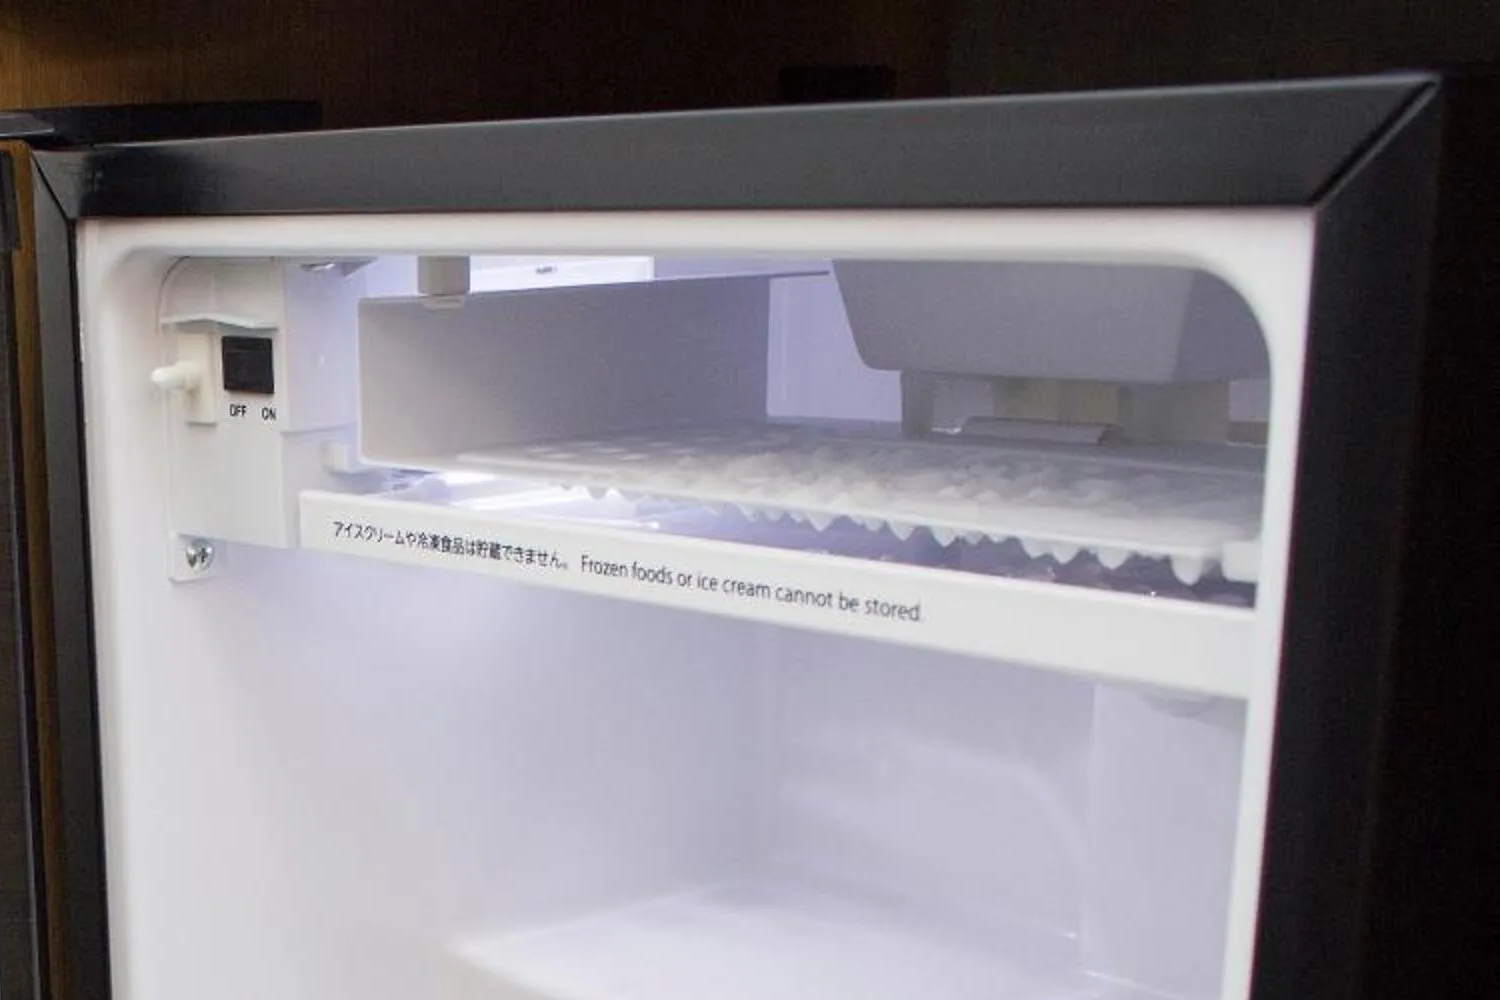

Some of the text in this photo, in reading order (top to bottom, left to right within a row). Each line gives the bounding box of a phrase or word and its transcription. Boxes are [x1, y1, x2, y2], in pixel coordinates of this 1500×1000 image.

[229, 404, 277, 420] OFF ON
[333, 521, 569, 570] アイスクリームや冷凍食品は貯蔵できません。
[581, 554, 629, 579] Frozen
[631, 563, 674, 586] foods
[678, 572, 692, 587] or
[696, 570, 717, 591] ice
[722, 578, 771, 600] cream
[775, 587, 833, 608] cannot
[839, 590, 859, 613] be
